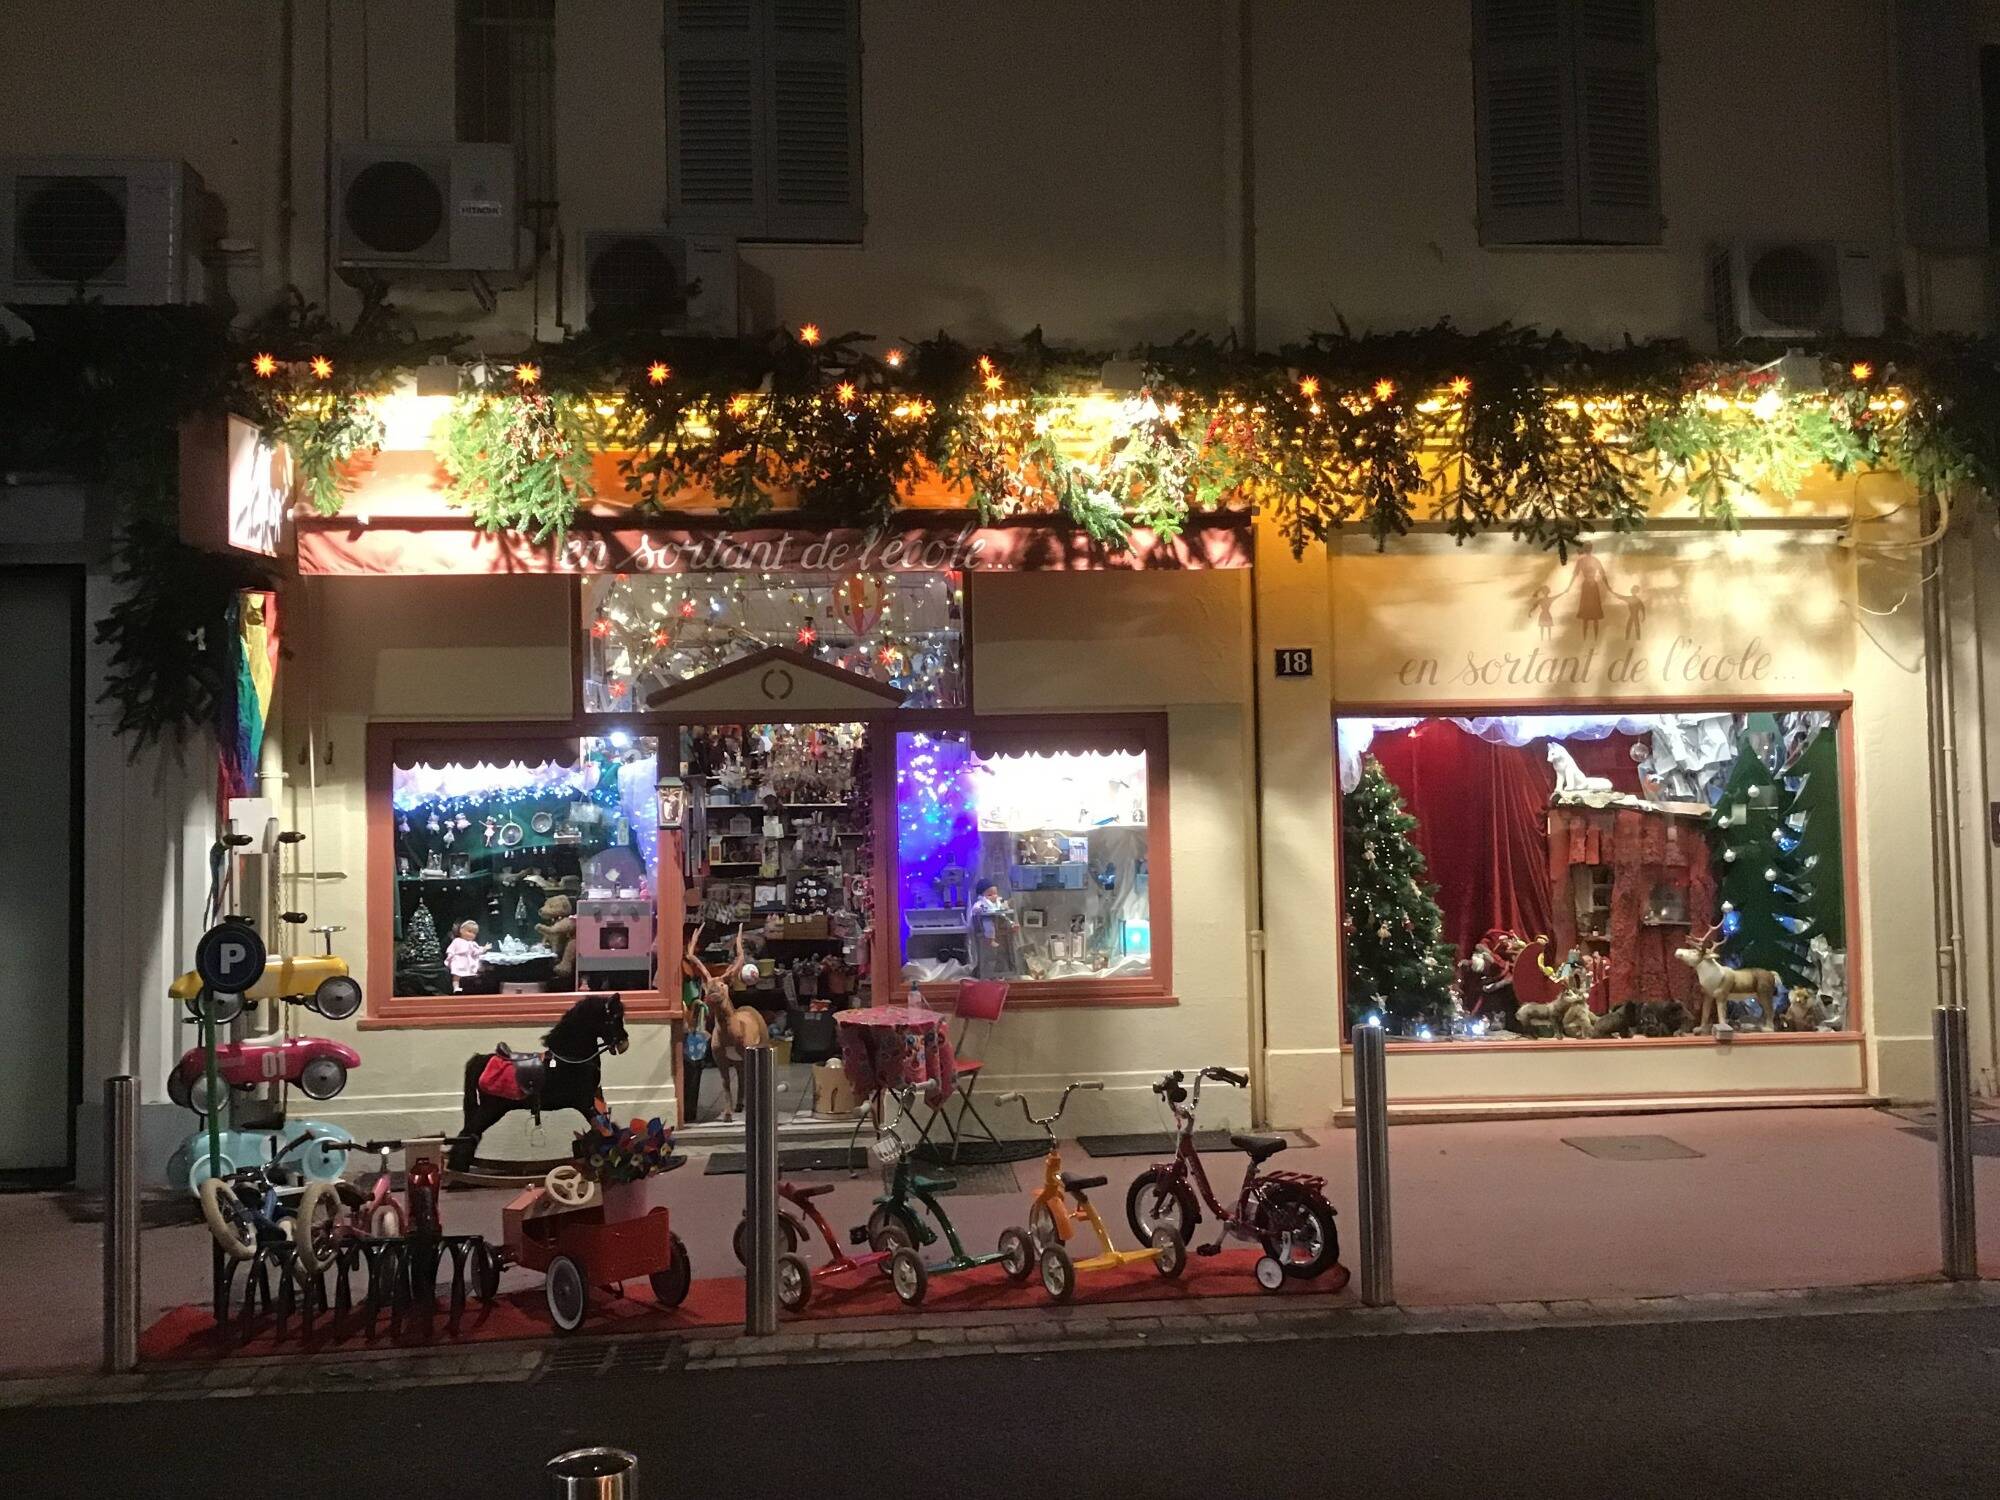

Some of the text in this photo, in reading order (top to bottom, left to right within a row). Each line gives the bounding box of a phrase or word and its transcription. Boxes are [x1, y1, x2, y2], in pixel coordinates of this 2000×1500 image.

[559, 538, 608, 570] en
[616, 531, 793, 571] sortant
[800, 530, 850, 571] de
[1282, 651, 1308, 673] 18
[1394, 657, 1439, 687] en
[1448, 647, 1599, 687] sortant
[1607, 646, 1649, 684] de
[219, 942, 247, 975] P
[261, 1050, 287, 1078] 01
